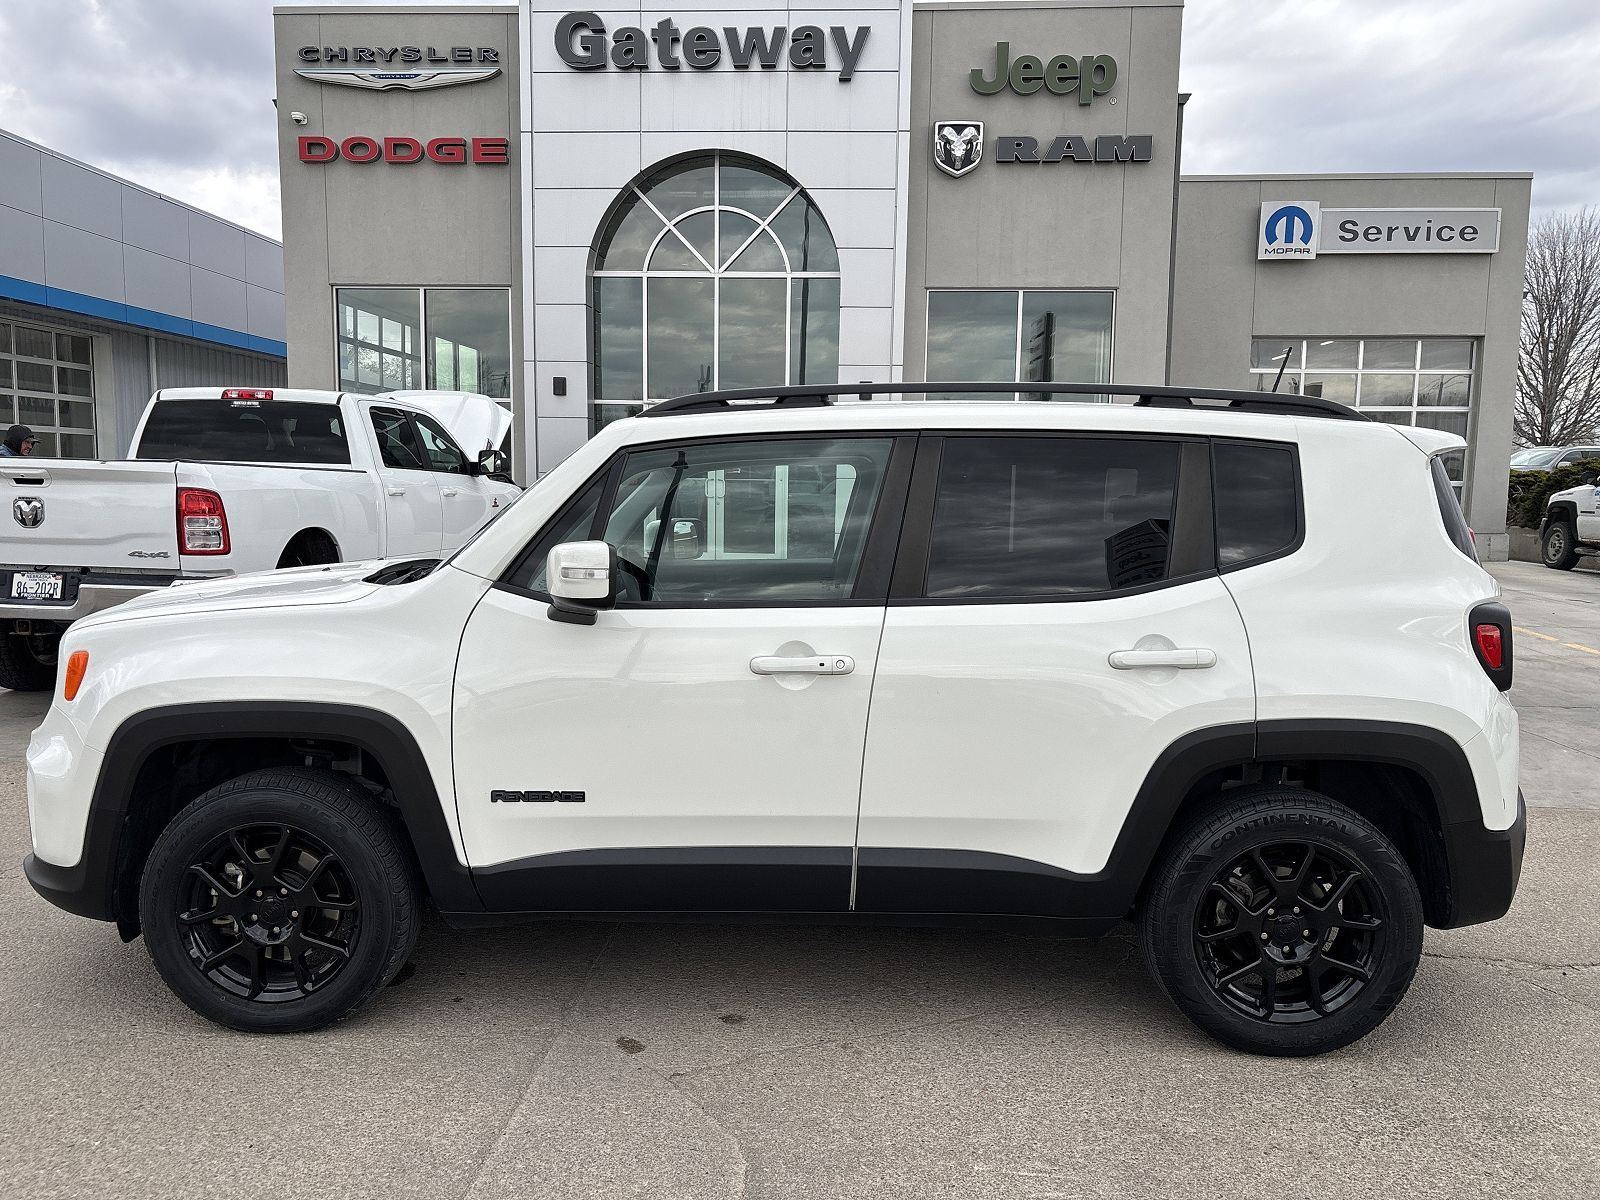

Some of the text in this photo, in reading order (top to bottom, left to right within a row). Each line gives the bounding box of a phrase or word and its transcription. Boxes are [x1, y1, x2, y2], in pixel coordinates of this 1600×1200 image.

[298, 45, 501, 63] CHRYSLER
[554, 11, 871, 82] Gateway
[970, 41, 1118, 106] Jeep
[298, 136, 510, 165] DODGE
[996, 134, 1154, 164] RAM
[1338, 218, 1480, 242] Service
[1264, 247, 1311, 255] MOPAR
[16, 581, 59, 596] 86-202R
[490, 789, 586, 803] RENEGADE
[1210, 813, 1350, 850] CONTINENTAL
